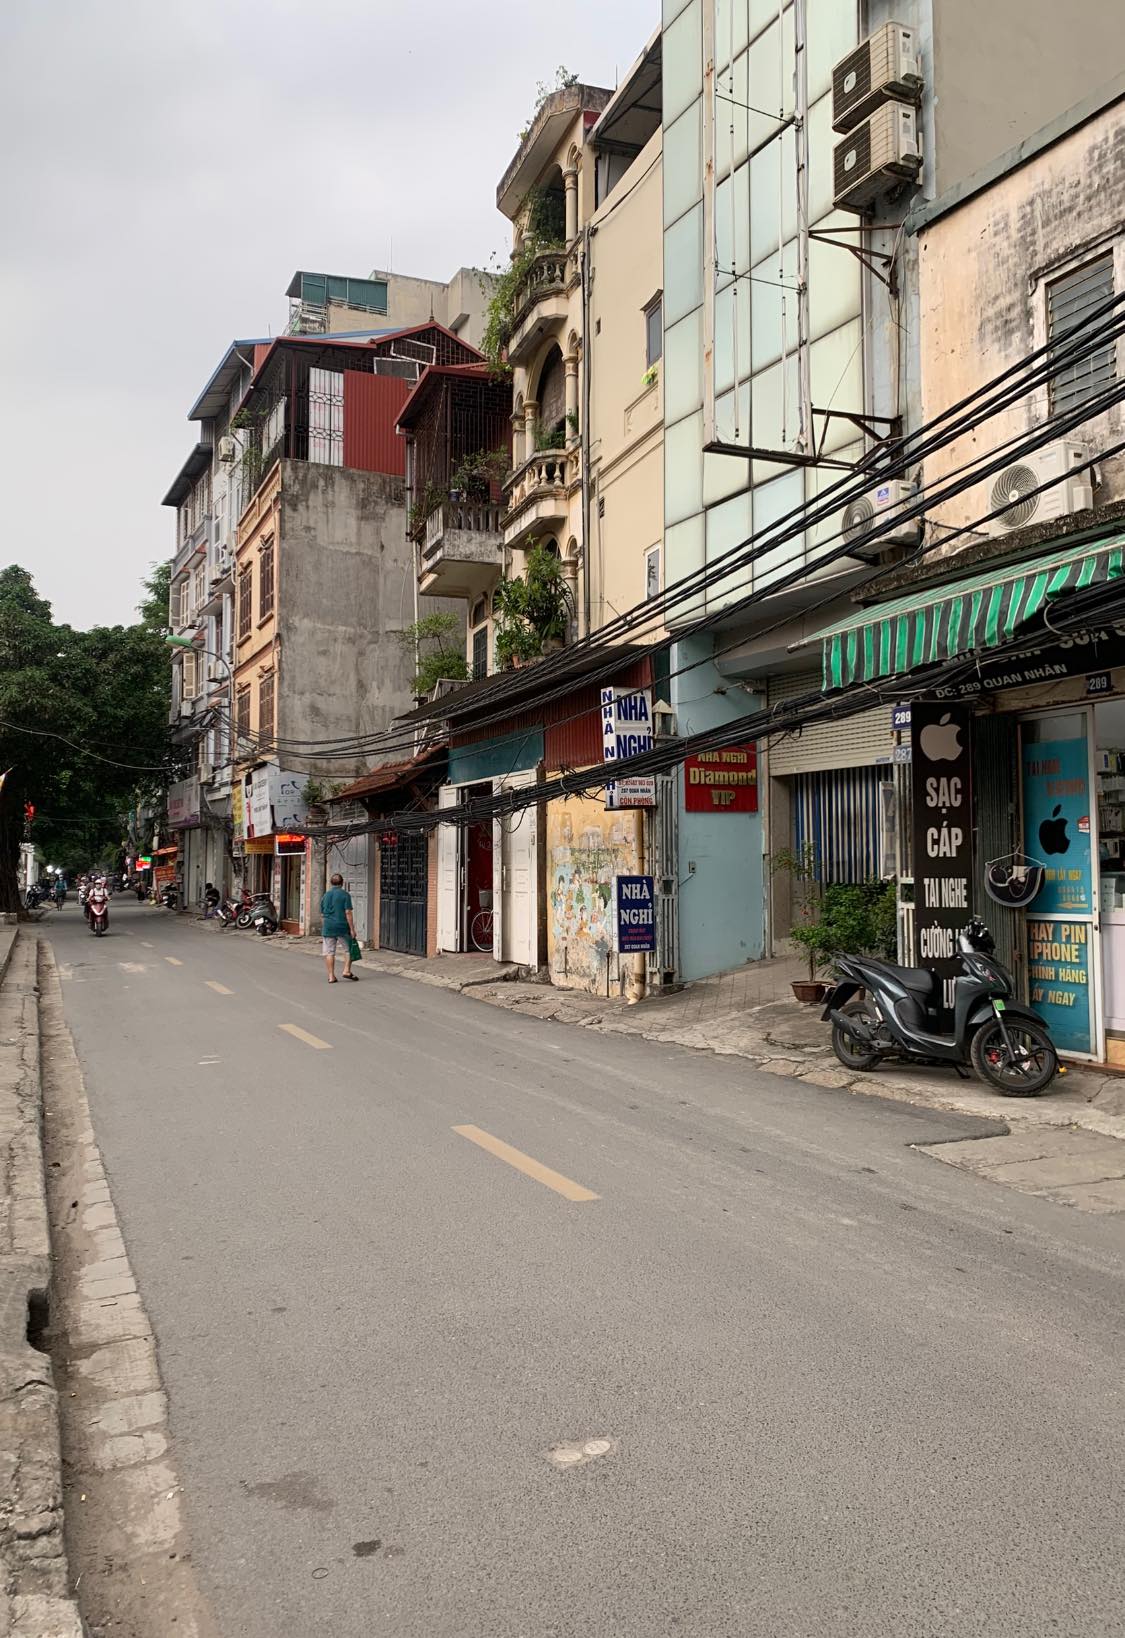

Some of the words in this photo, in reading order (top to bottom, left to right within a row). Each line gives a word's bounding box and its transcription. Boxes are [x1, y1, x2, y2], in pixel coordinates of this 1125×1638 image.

[960, 681, 981, 693] 289
[984, 673, 1022, 688] QUAN
[1025, 664, 1068, 680] NHÂN
[1089, 676, 1107, 690] 289
[617, 690, 648, 721] NHÀ
[895, 711, 911, 724] 289
[895, 748, 912, 761] 287
[689, 767, 756, 785] Diamond
[711, 790, 736, 805] VIP
[926, 777, 962, 814] SẠC
[927, 821, 963, 858] CÁP
[622, 879, 650, 900] NHÀ
[924, 878, 939, 908] TAI
[941, 878, 968, 908] NGHE
[620, 902, 653, 925] NGHỈ
[920, 920, 953, 958] CƯỜNG
[1061, 924, 1085, 943] PIN
[1030, 942, 1080, 962] IPHONE
[1048, 990, 1075, 1007] NGAY
